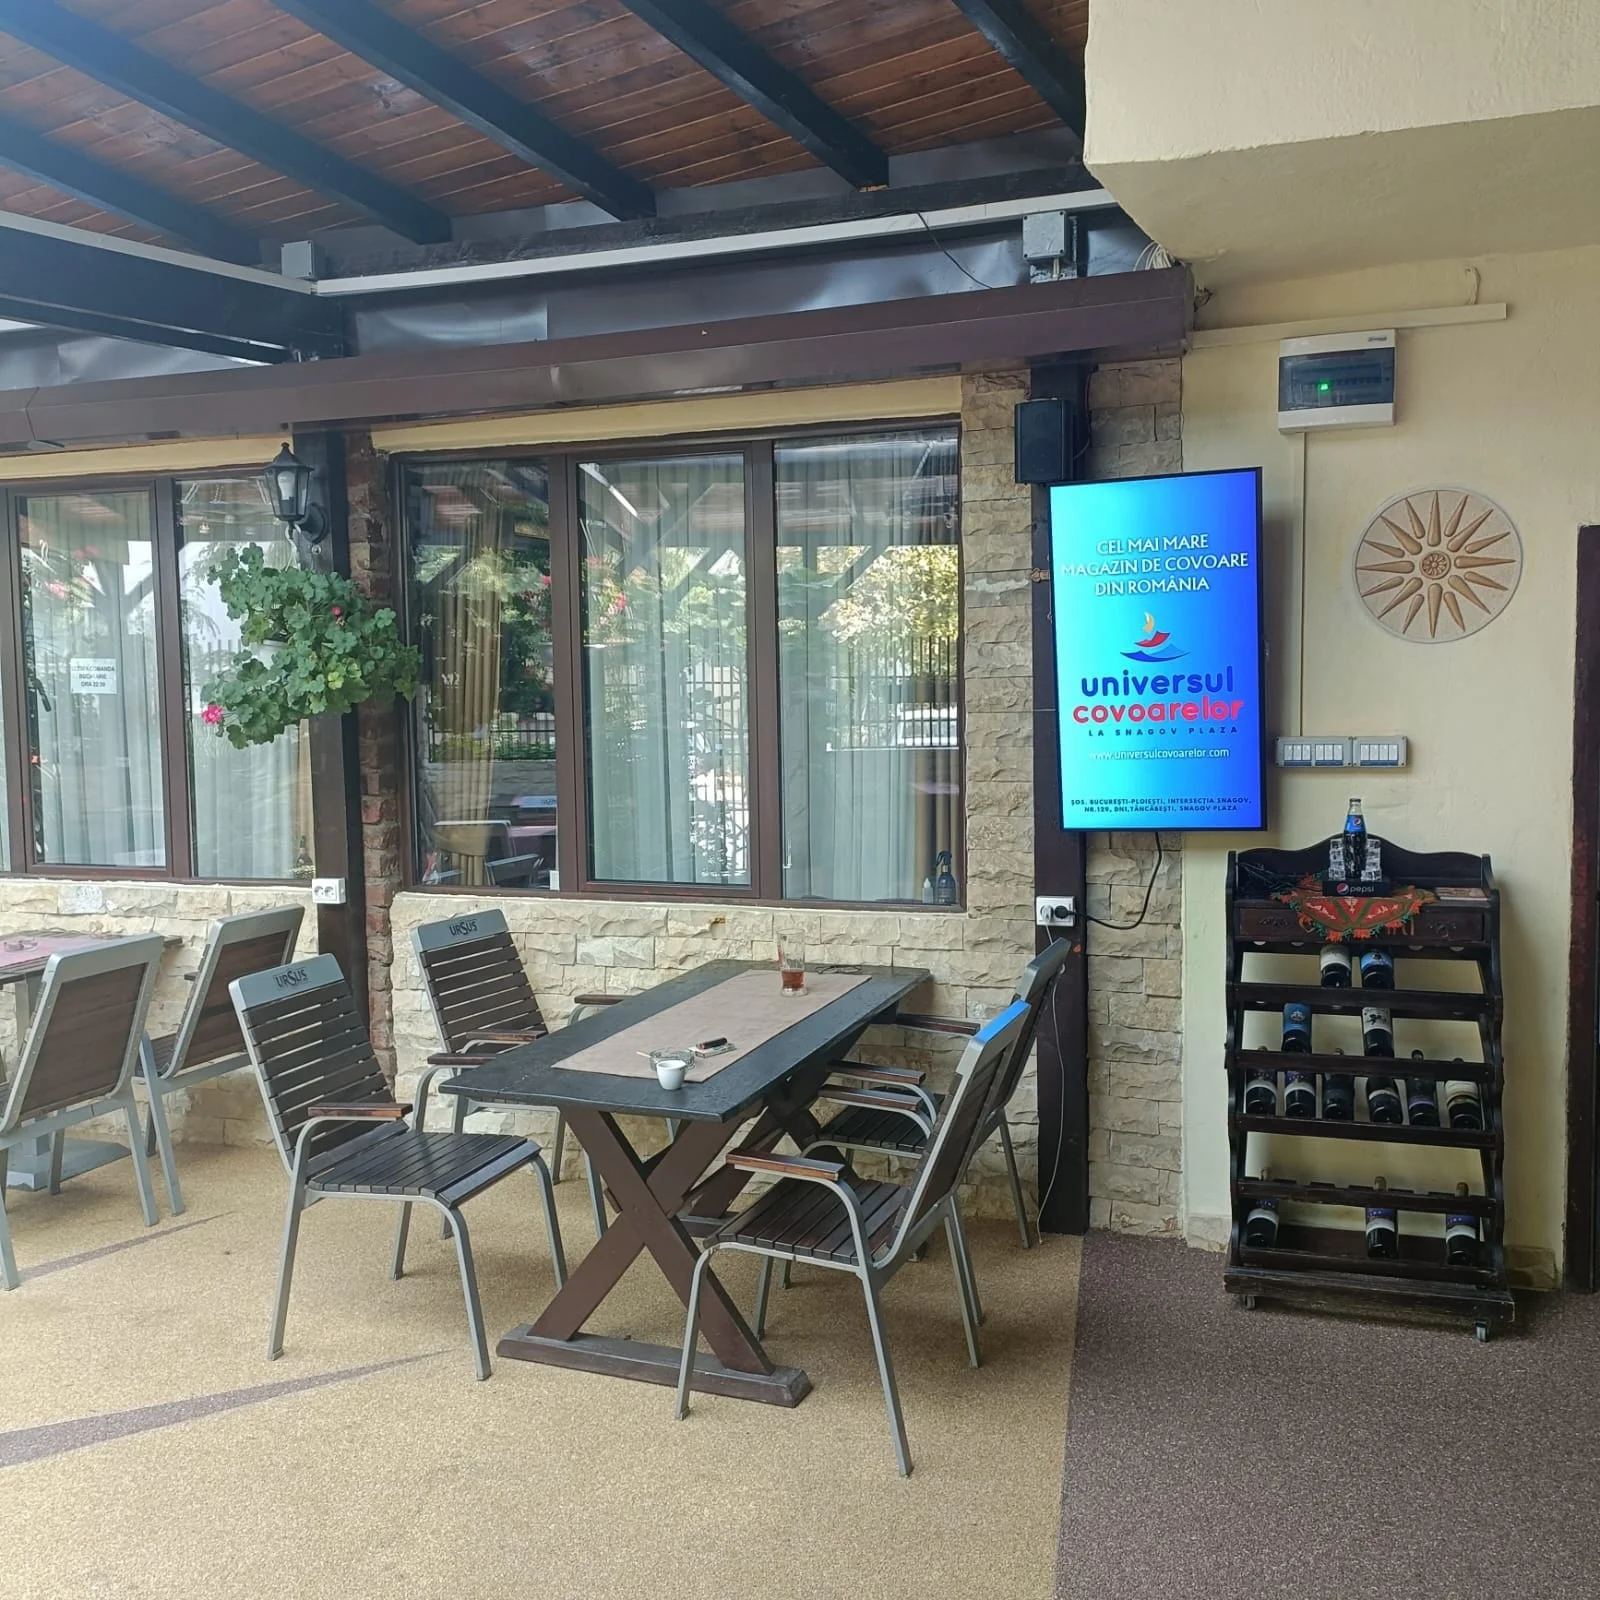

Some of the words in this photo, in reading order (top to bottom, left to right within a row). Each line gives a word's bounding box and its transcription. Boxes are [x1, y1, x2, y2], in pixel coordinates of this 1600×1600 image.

[1097, 539, 1123, 555] CEL
[1128, 537, 1159, 552] MAI
[1164, 533, 1208, 550] MARE
[1061, 559, 1138, 576] MAGAZIN
[1142, 558, 1161, 572] DE
[1165, 552, 1249, 571] COVOARE
[1095, 580, 1124, 596] DIN
[1128, 575, 1210, 594] ROMÂNIA
[1081, 665, 1233, 697] universul
[1072, 695, 1244, 723] covoarelor
[1088, 729, 1104, 737] LA
[1115, 727, 1177, 735] SNAGOV
[1188, 726, 1238, 734] PLAZA
[1088, 748, 1230, 761] www.universulcovoarelor.com
[1350, 885, 1375, 894] pepsi
[450, 919, 478, 936] URSUS
[276, 968, 308, 988] URSUS
